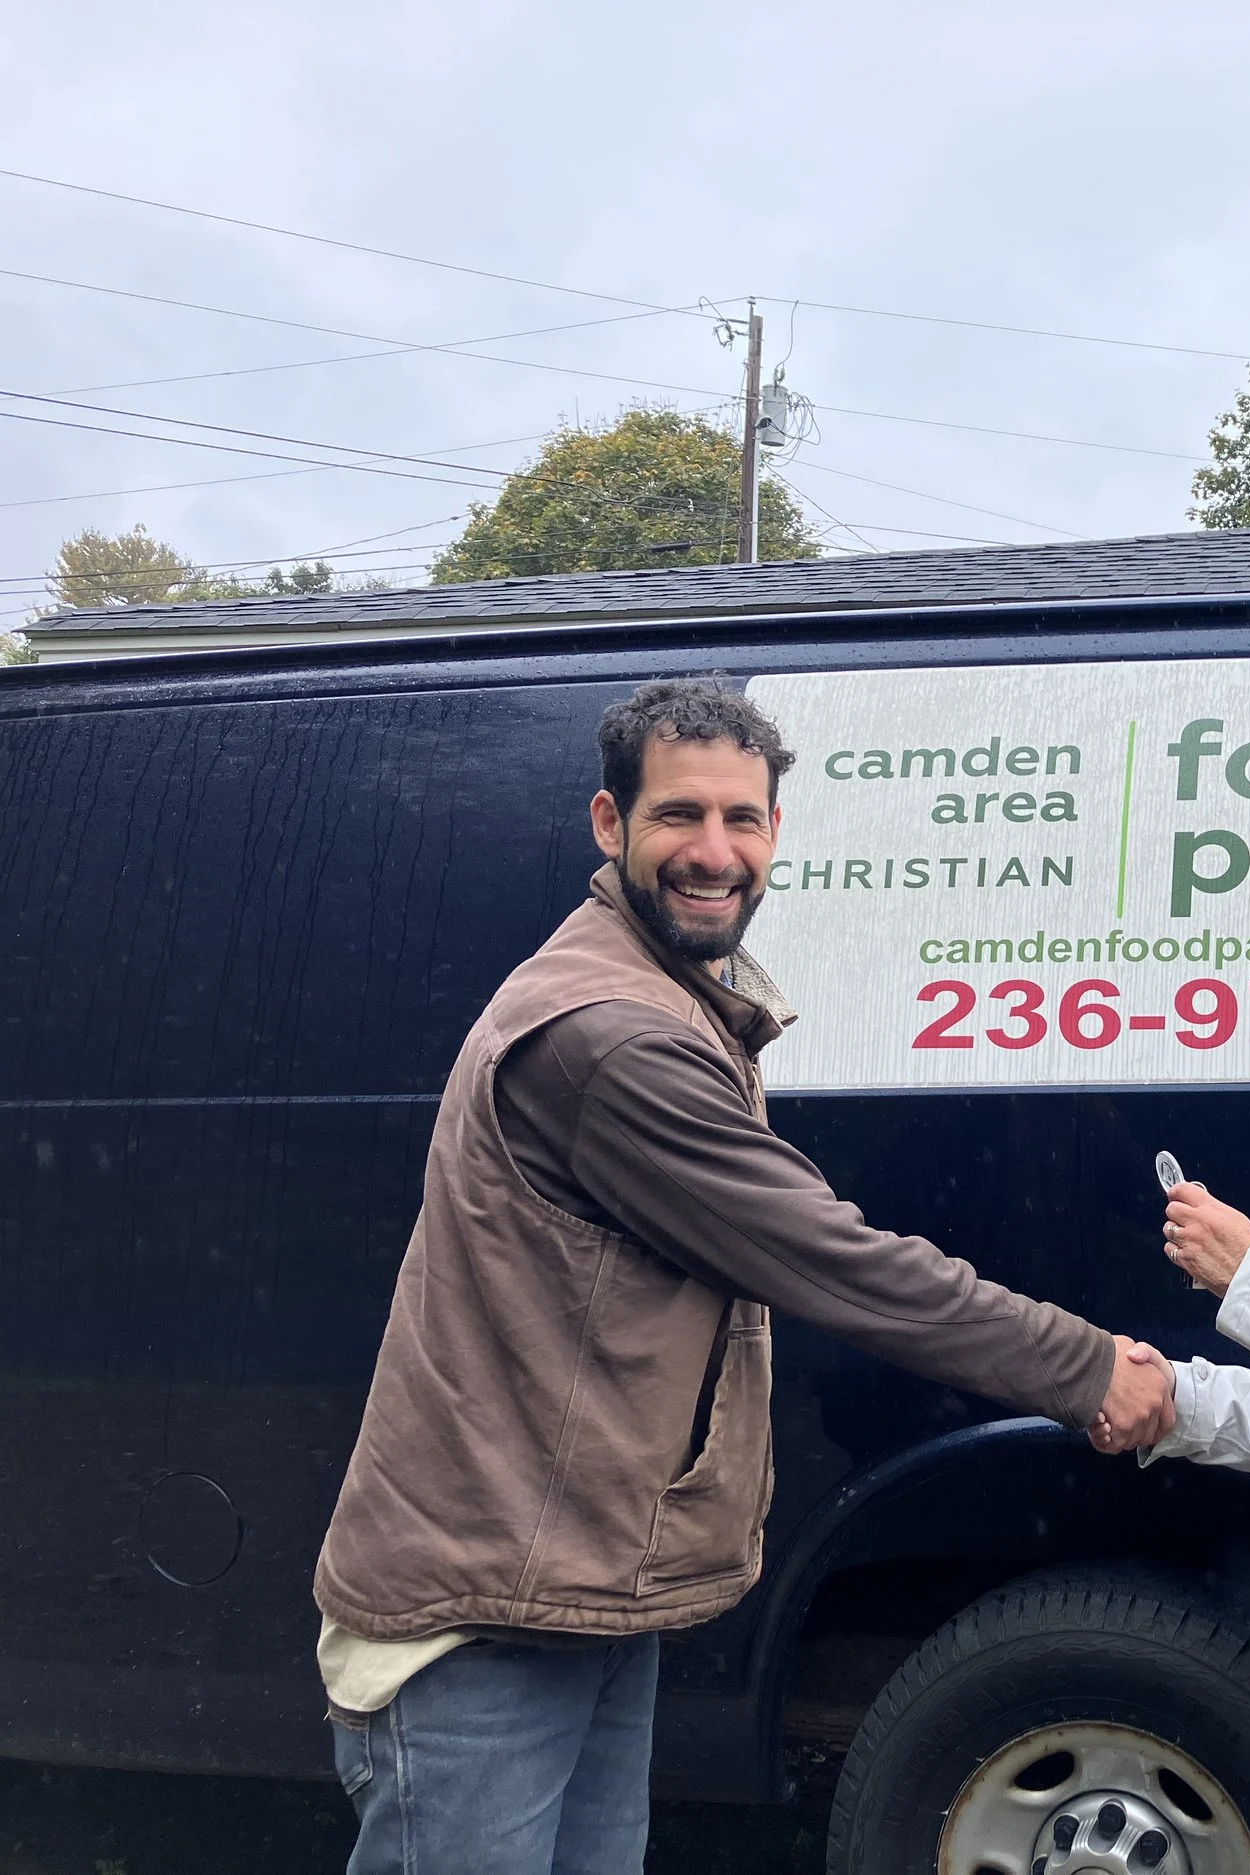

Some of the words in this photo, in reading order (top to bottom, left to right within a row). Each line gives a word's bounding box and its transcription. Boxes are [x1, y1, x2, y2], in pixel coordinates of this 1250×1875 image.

[824, 737, 1082, 780] camden
[930, 790, 1078, 824] area
[767, 856, 1074, 890] CHRISTIAN
